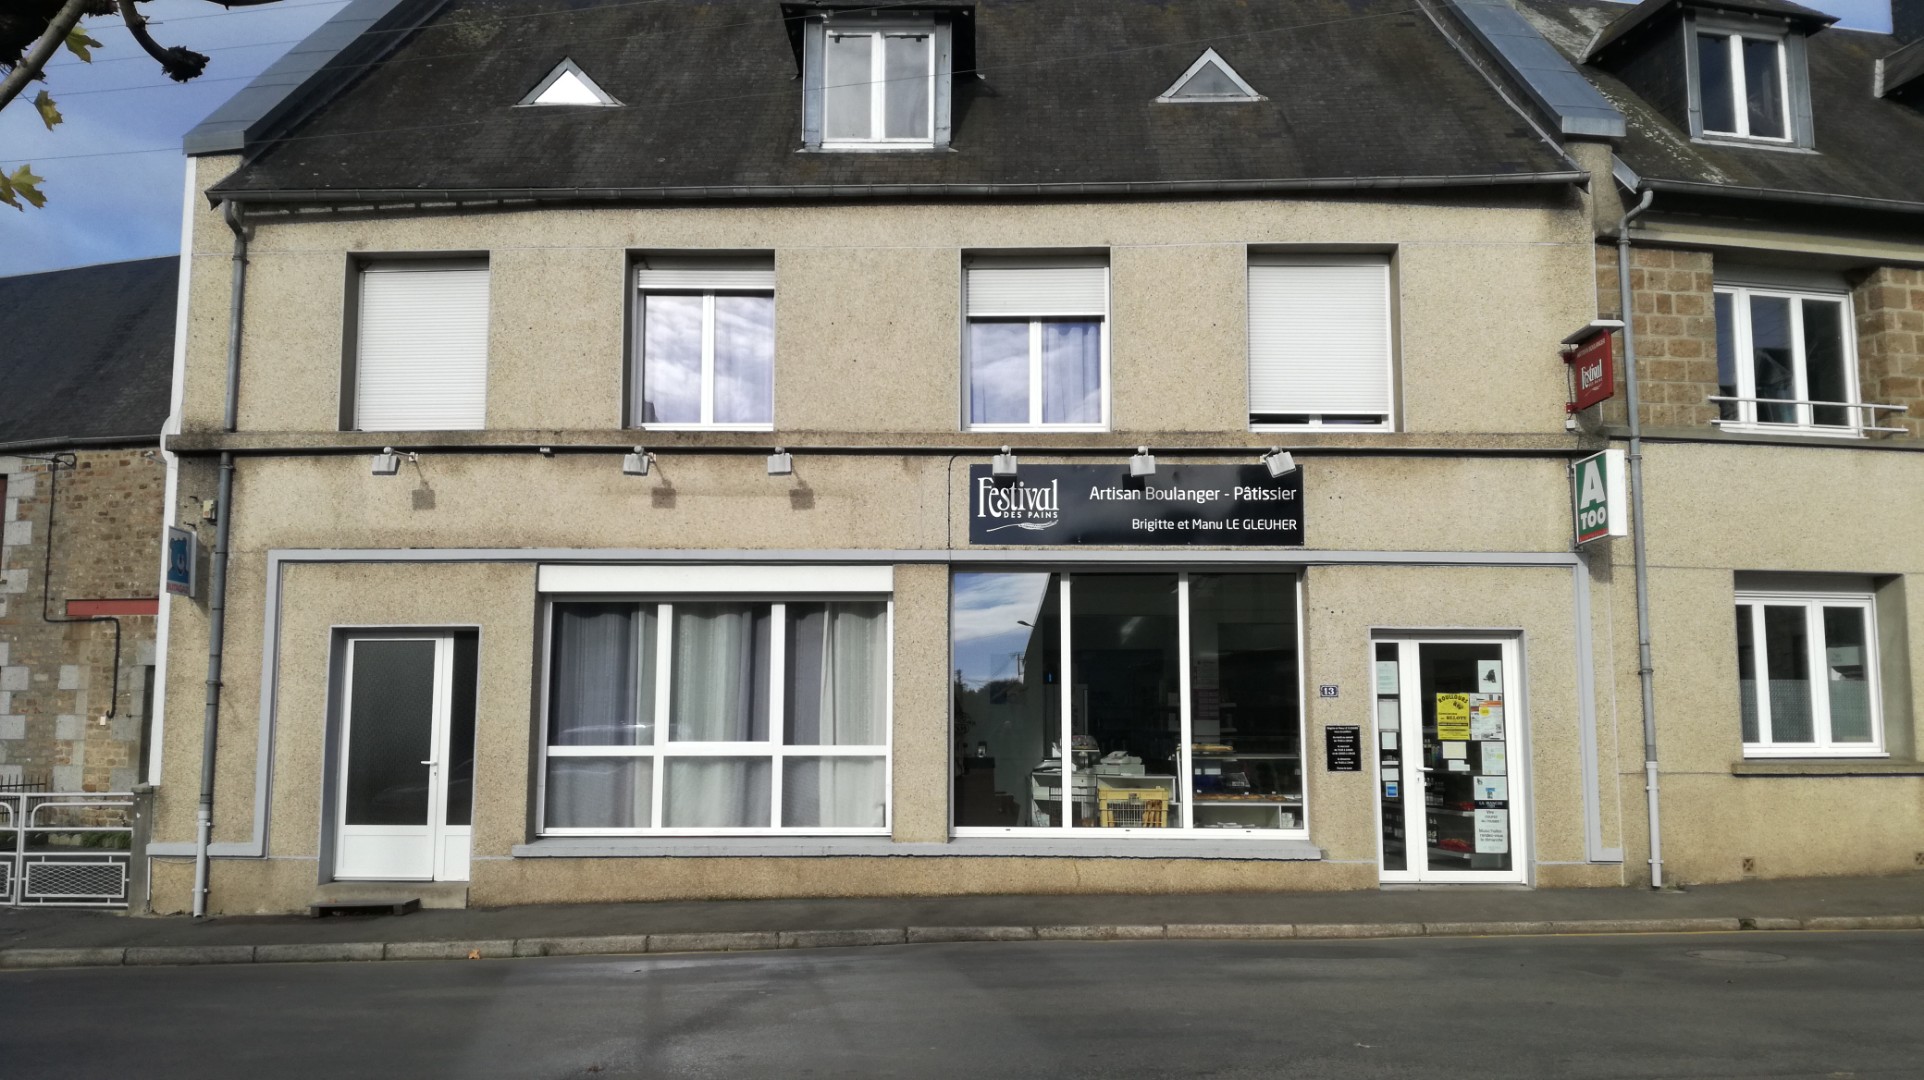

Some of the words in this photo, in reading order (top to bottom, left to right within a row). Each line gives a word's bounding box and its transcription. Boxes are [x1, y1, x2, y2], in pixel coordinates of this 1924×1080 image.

[1581, 358, 1602, 390] Festival
[1089, 486, 1141, 500] Artisan
[1145, 486, 1220, 504] Boulanger
[1234, 486, 1297, 501] Pâtissier
[1580, 459, 1606, 509] A
[977, 477, 1060, 518] Festival
[1132, 518, 1175, 532] Brigitte
[1177, 519, 1190, 530] et
[1192, 519, 1223, 530] Manu
[1226, 519, 1240, 530] LE
[1243, 519, 1297, 530] GLEUHER
[1580, 509, 1607, 531] TOO
[1323, 687, 1335, 696] 13
